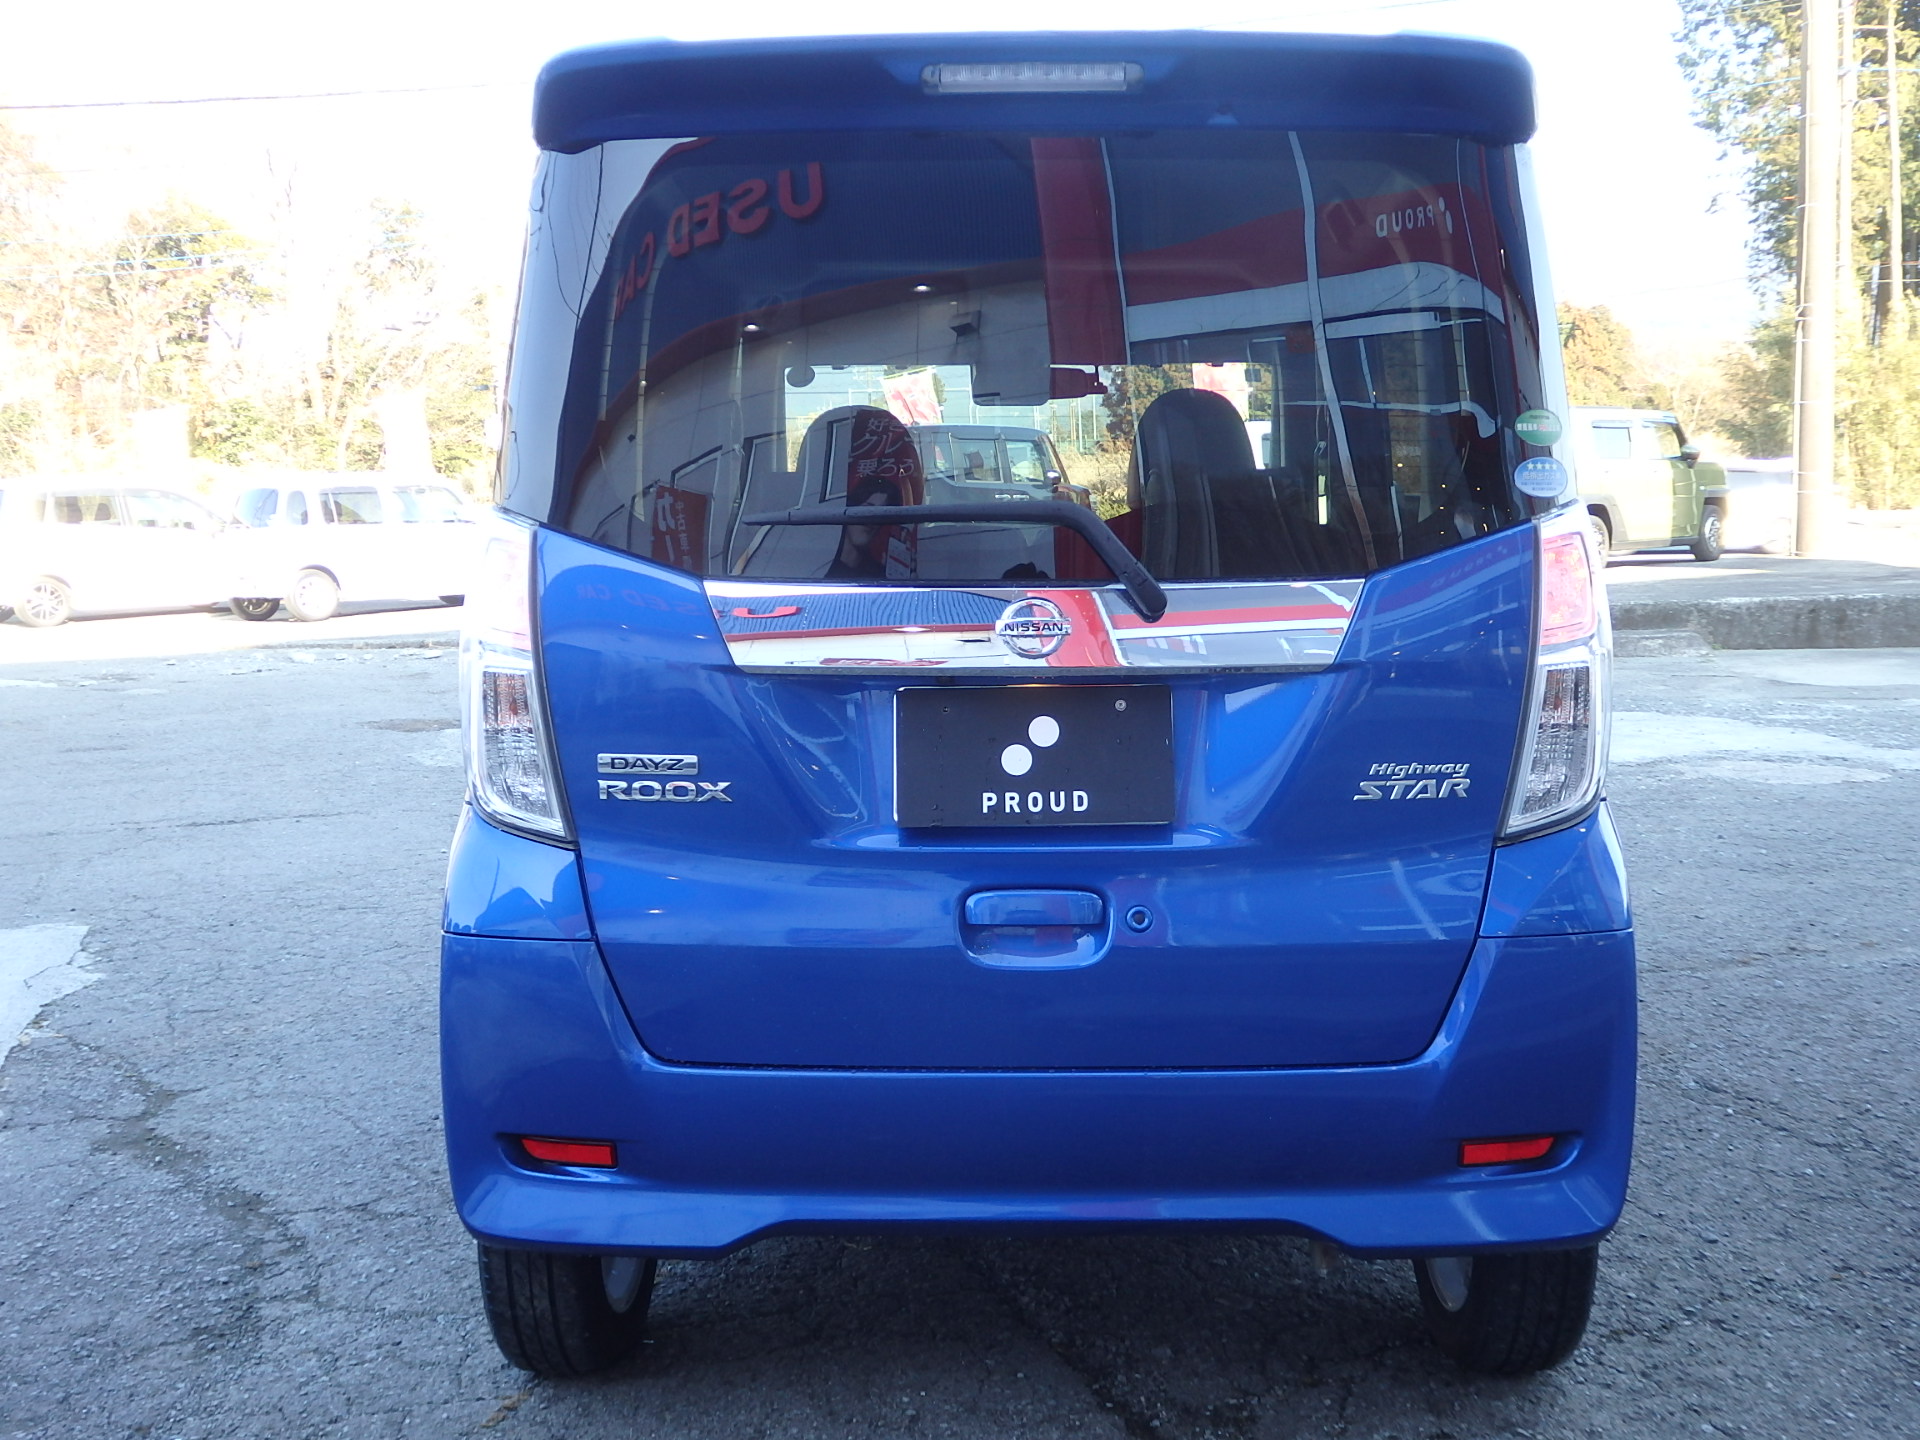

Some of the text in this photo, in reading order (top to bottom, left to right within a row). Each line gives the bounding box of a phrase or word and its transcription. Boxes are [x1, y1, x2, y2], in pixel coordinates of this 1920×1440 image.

[1004, 622, 1064, 632] NISSAN
[610, 757, 685, 771] DAYZ
[1368, 762, 1470, 780] Highway
[597, 779, 733, 803] ROOX
[1353, 778, 1471, 801] STAR
[982, 790, 1089, 814] PROUD
